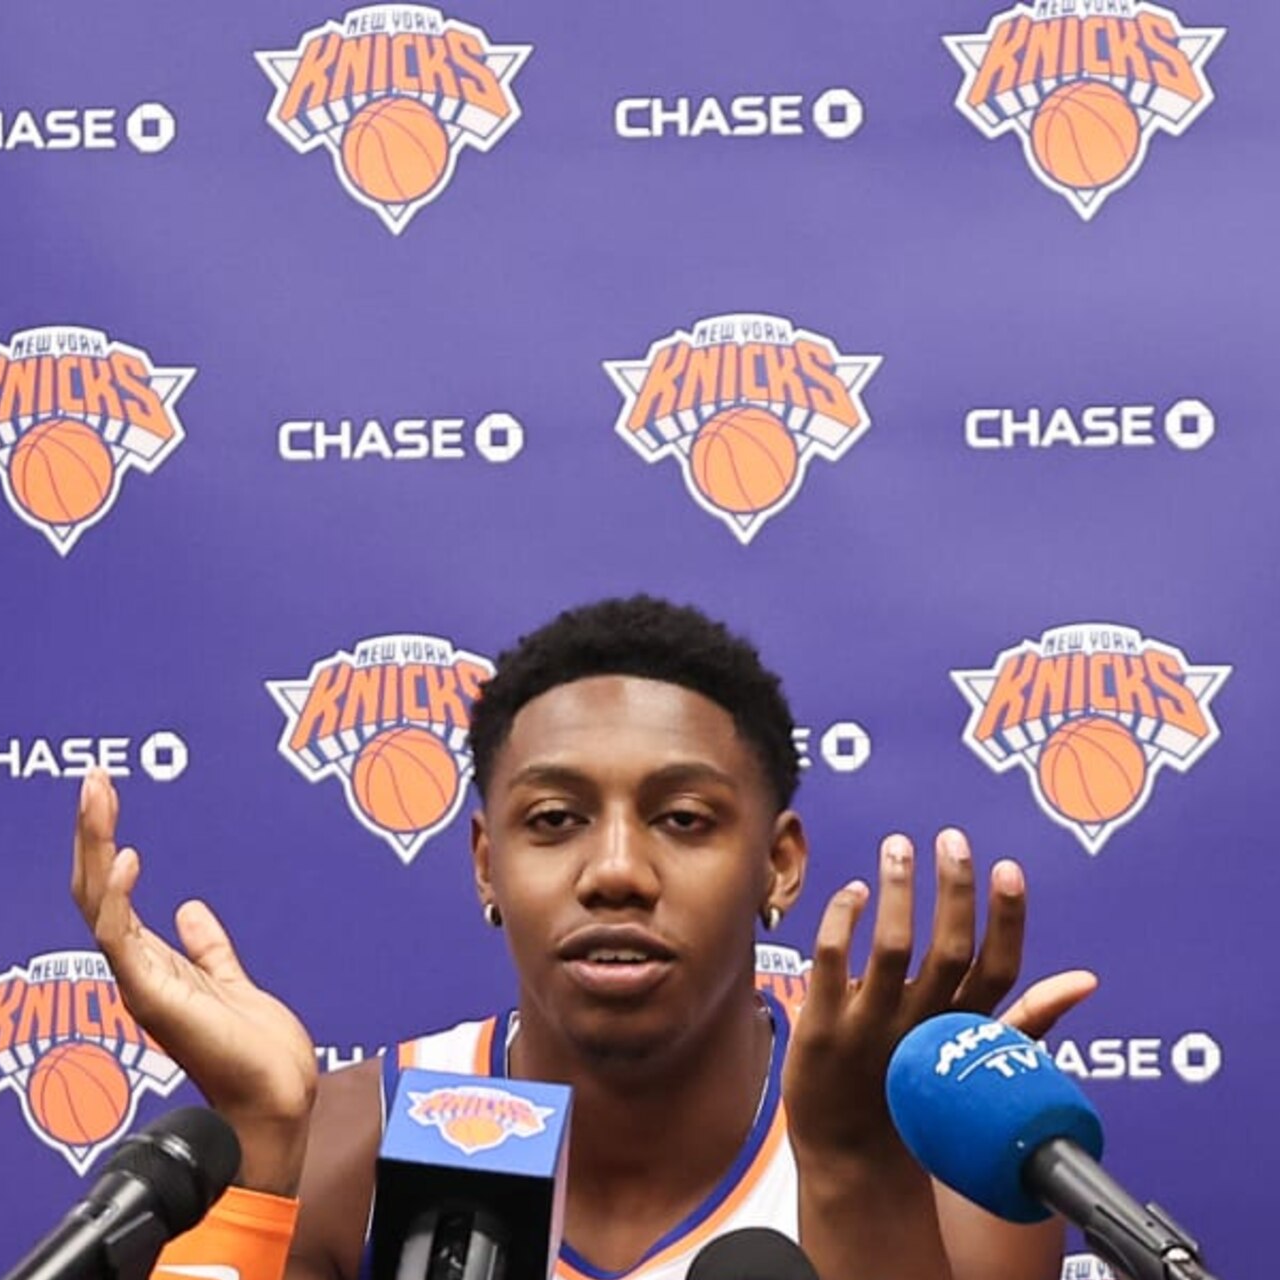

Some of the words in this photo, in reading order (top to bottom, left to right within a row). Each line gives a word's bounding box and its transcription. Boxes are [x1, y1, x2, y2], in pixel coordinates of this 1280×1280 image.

[347, 12, 387, 35] NEW
[392, 9, 440, 34] YORK
[281, 30, 510, 121] KNICKS
[968, 13, 1202, 106] KNICKS
[614, 94, 805, 139] CHASE
[12, 333, 52, 358] NEW
[57, 331, 104, 356] YORK
[695, 322, 735, 346] NEW
[741, 320, 789, 343] YORK
[629, 340, 859, 430] KNICKS
[277, 418, 466, 462] CHASE
[964, 405, 1157, 450] CHASE
[356, 640, 396, 666] NEW
[401, 639, 449, 665] YORK
[1043, 631, 1084, 655] NEW
[1089, 630, 1138, 653] YORK
[975, 650, 1209, 742] KNICKS
[74, 956, 107, 979] YOR
[760, 950, 799, 973] ORK
[1044, 1038, 1162, 1079] ASE
[1064, 1260, 1092, 1280] EW
